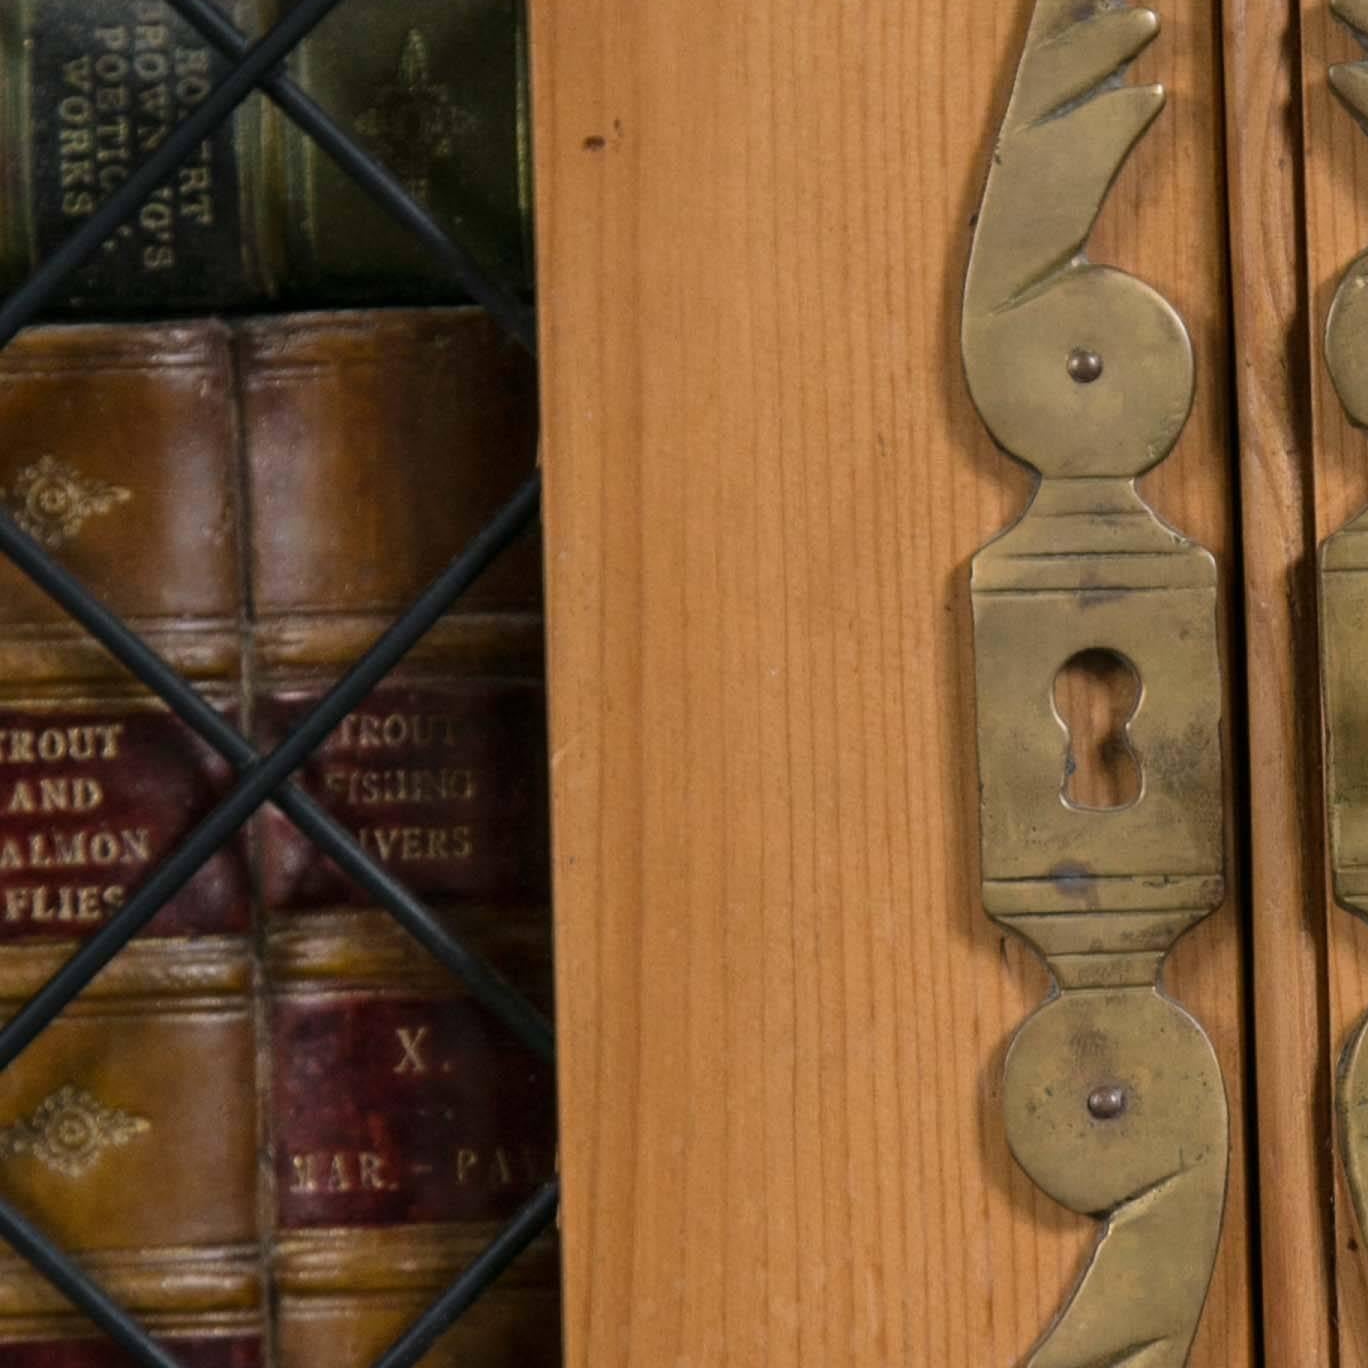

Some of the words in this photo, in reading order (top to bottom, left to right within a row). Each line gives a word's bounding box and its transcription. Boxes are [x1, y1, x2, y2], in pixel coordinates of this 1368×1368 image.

[58, 54, 94, 216] WORKS
[95, 25, 132, 250] POETIC
[173, 46, 214, 225] RORT
[7, 777, 104, 813] AND
[354, 826, 474, 861] IVERS
